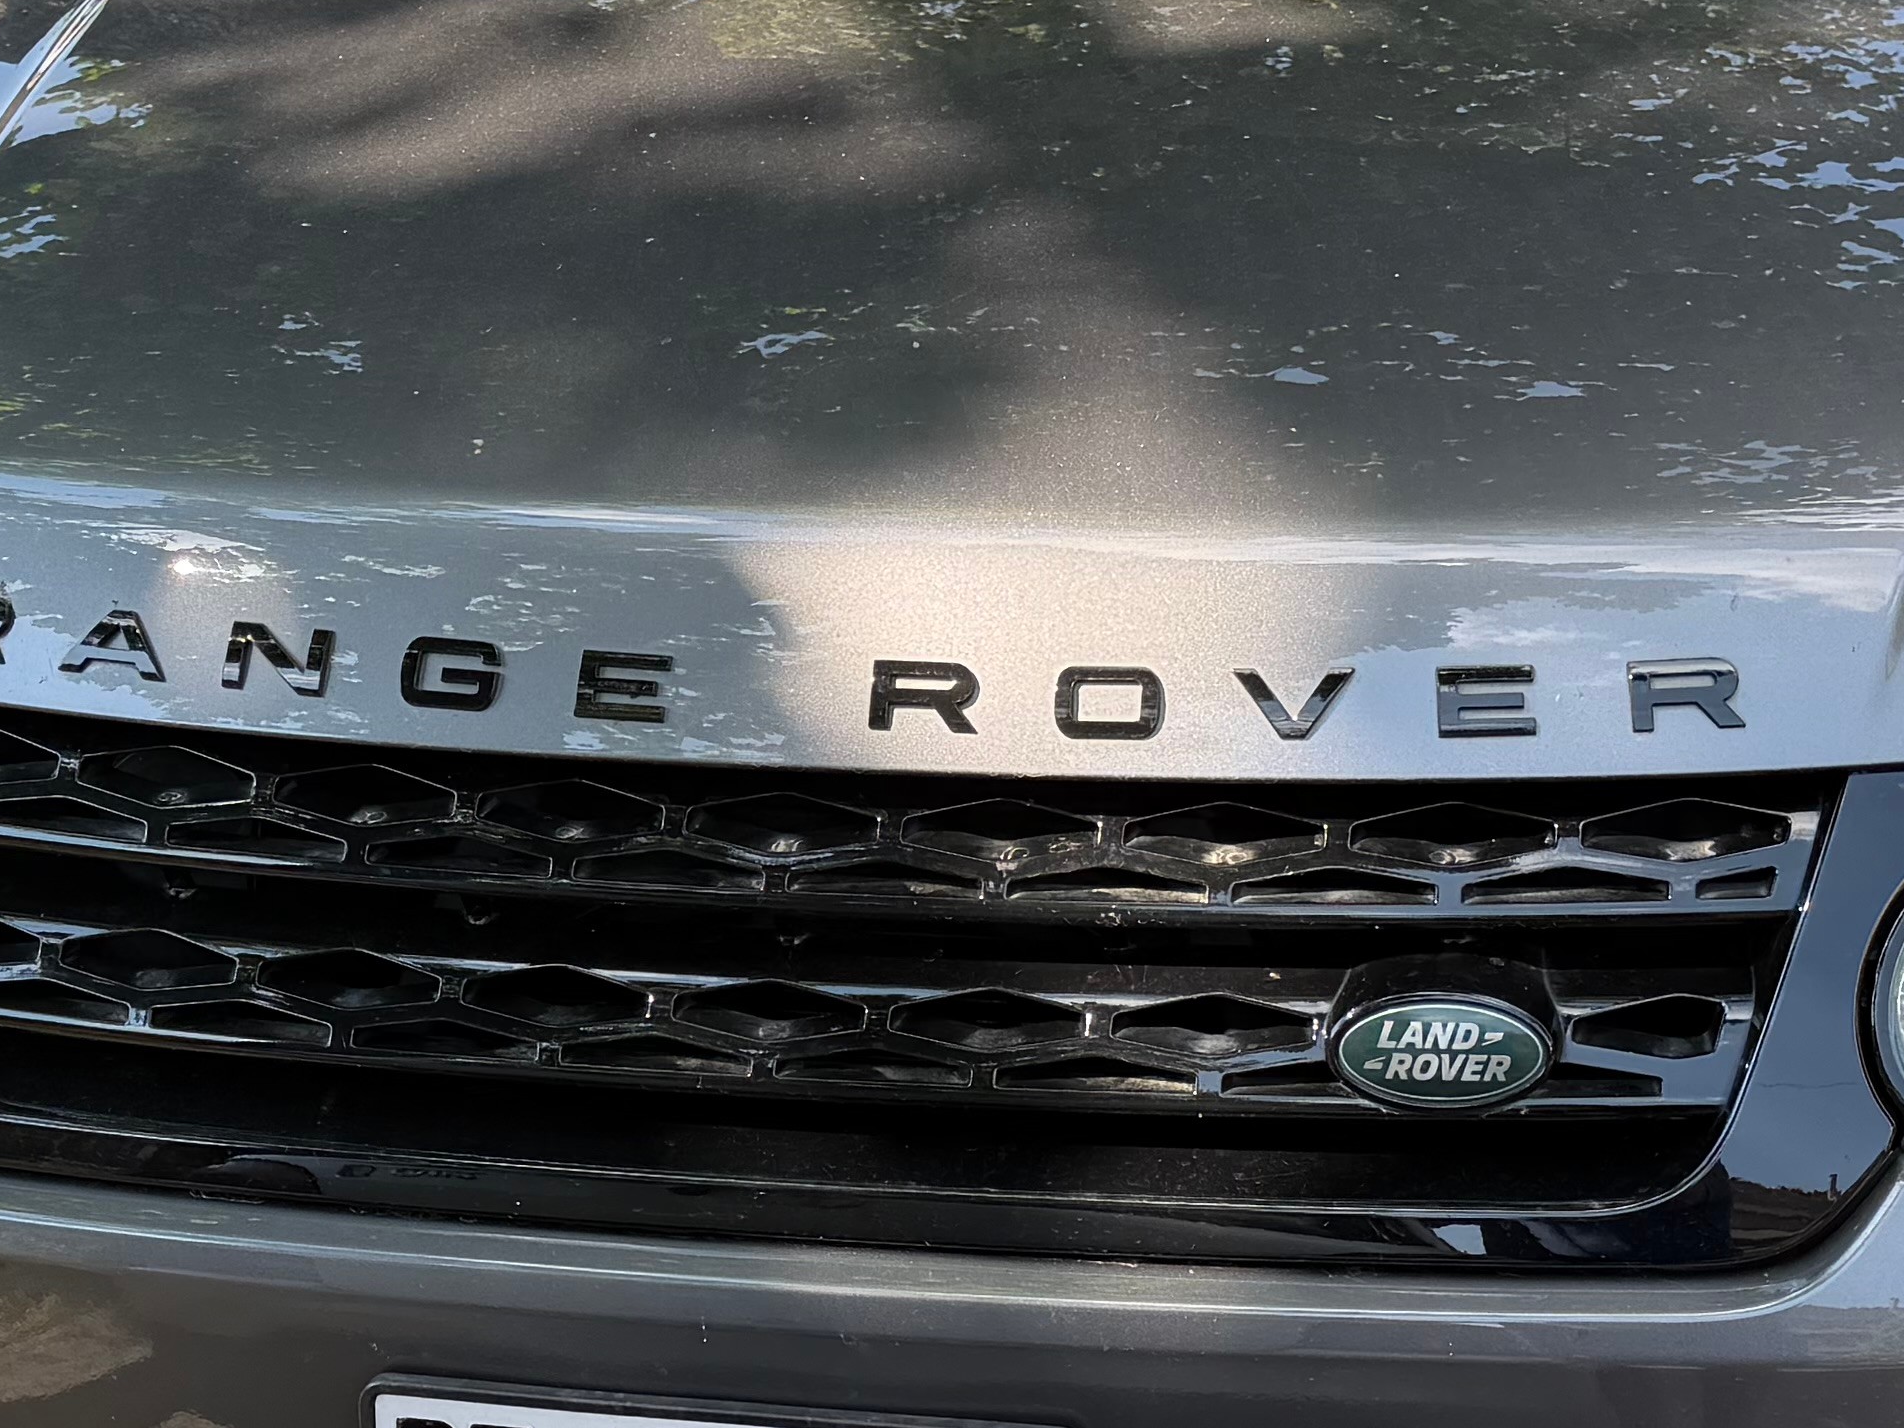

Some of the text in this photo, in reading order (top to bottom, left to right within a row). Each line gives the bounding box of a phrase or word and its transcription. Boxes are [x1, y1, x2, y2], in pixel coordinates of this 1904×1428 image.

[868, 657, 1746, 740] ROVER
[1377, 1020, 1480, 1050] LAND
[1385, 1053, 1512, 1082] ROVER
